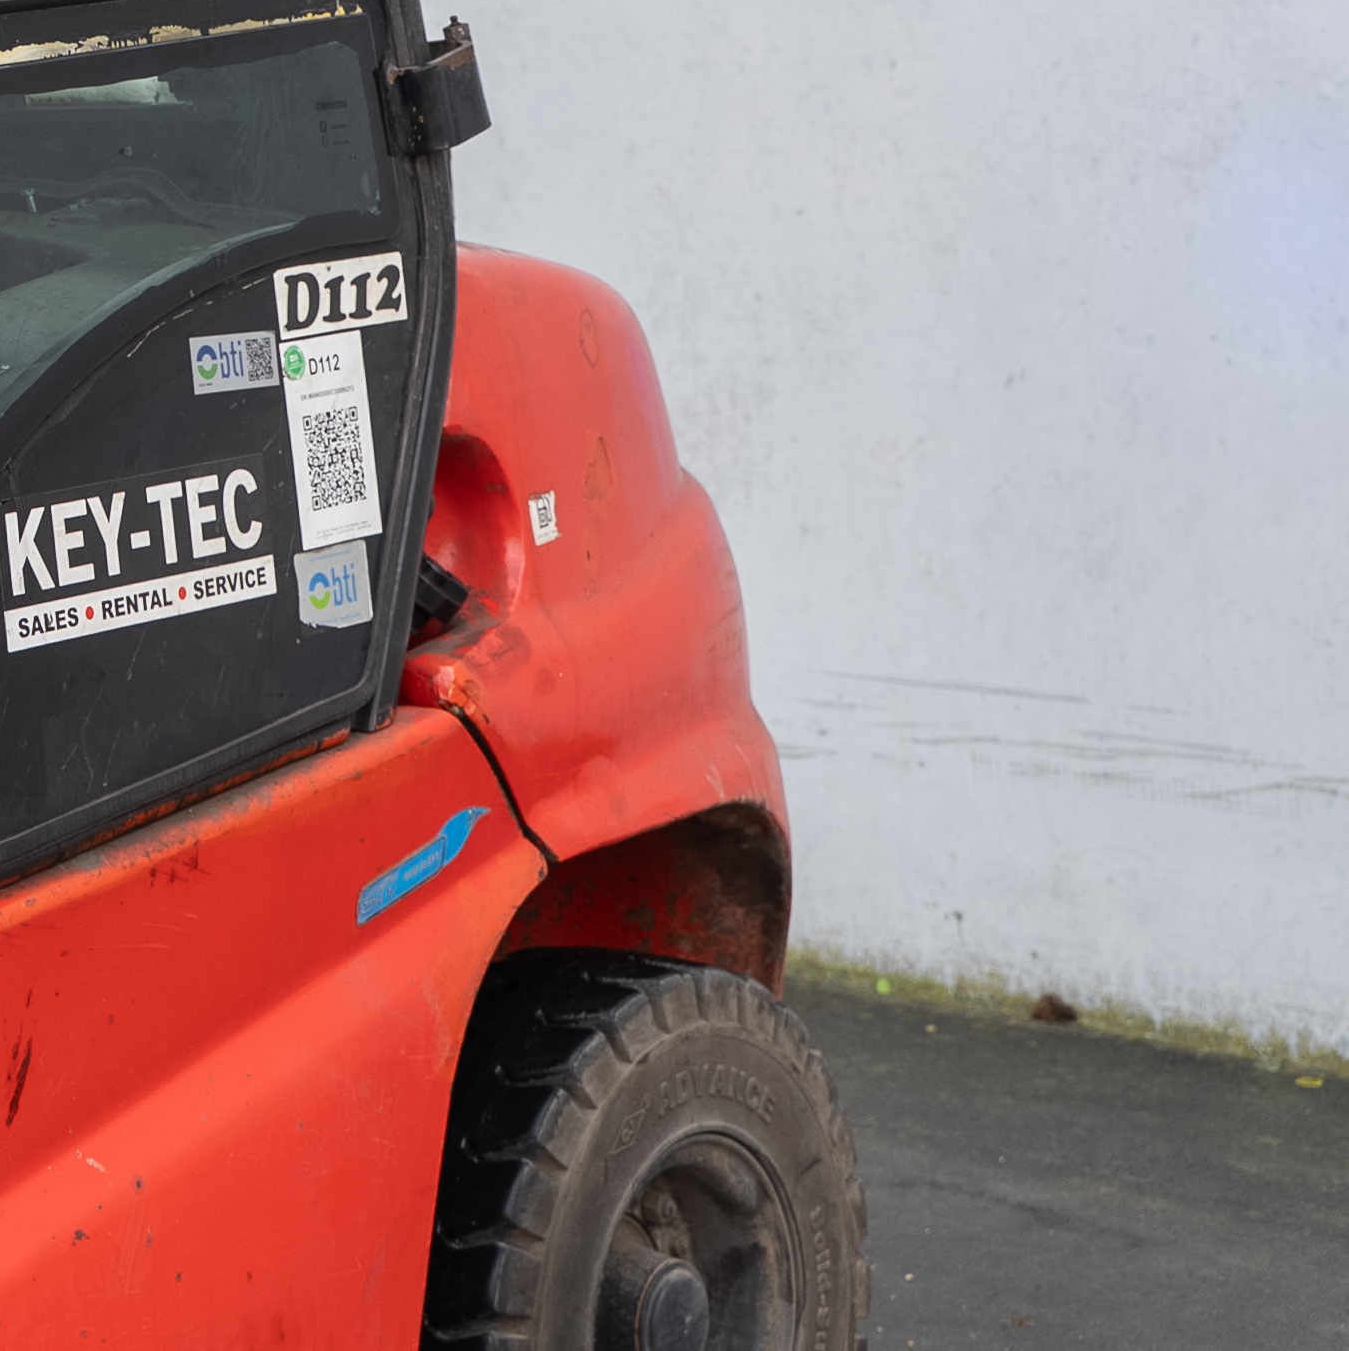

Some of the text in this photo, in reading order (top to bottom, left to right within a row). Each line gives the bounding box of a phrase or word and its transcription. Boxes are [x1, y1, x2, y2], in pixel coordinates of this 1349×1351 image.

[284, 264, 402, 332] D112
[308, 353, 341, 376] D112
[4, 468, 263, 597] KEY-TEC
[18, 567, 267, 638] SALES RENTAL SERVICE
[657, 1063, 776, 1125] ADVANCE
